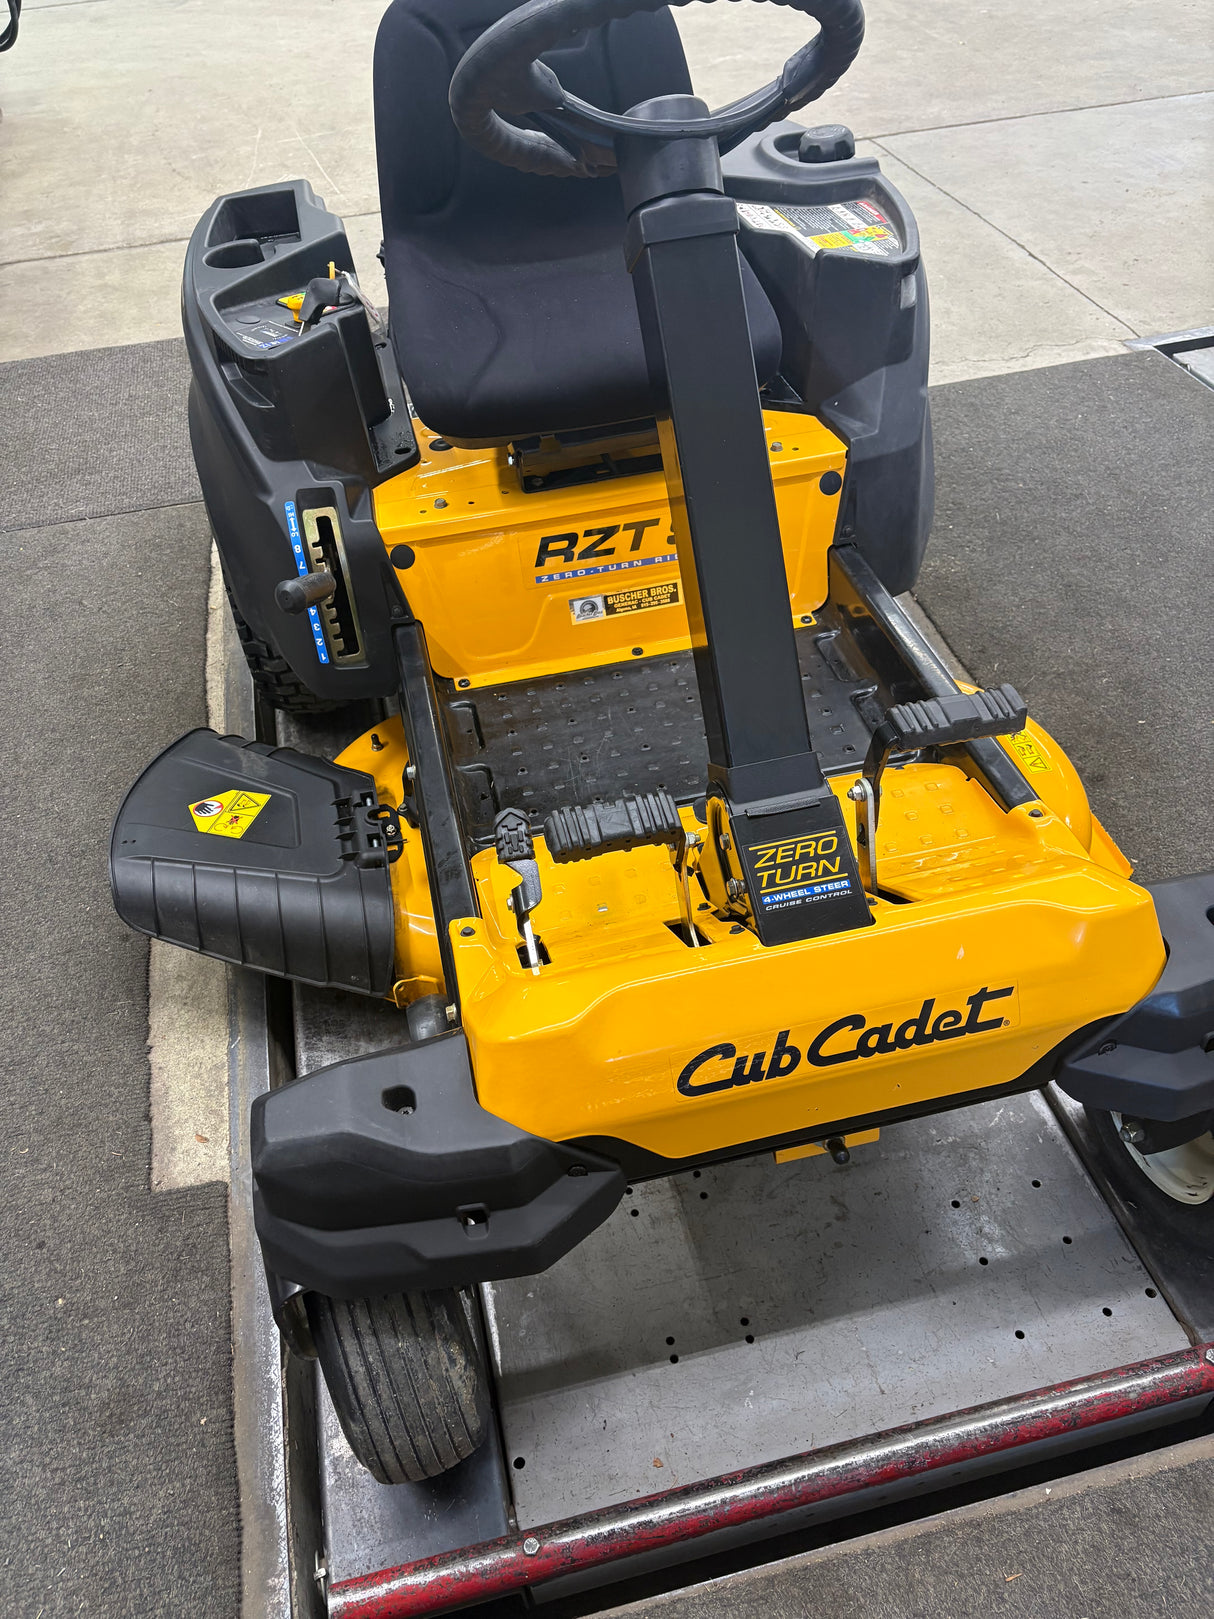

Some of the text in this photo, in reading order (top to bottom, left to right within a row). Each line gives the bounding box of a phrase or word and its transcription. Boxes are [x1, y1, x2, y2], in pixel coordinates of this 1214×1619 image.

[294, 544, 301, 554] 8
[534, 518, 660, 568] RZT
[299, 561, 306, 570] 7
[607, 584, 677, 605] BUSCHER BROS.
[313, 623, 320, 631] 3
[316, 638, 323, 646] 2
[321, 653, 326, 661] 1
[754, 836, 838, 869] ZERO
[757, 856, 840, 888] TURN
[763, 880, 849, 903] 4-WHEEL STEER
[765, 889, 853, 911] CRUISE CONTROL
[677, 986, 1015, 1097] Cub Cadet
